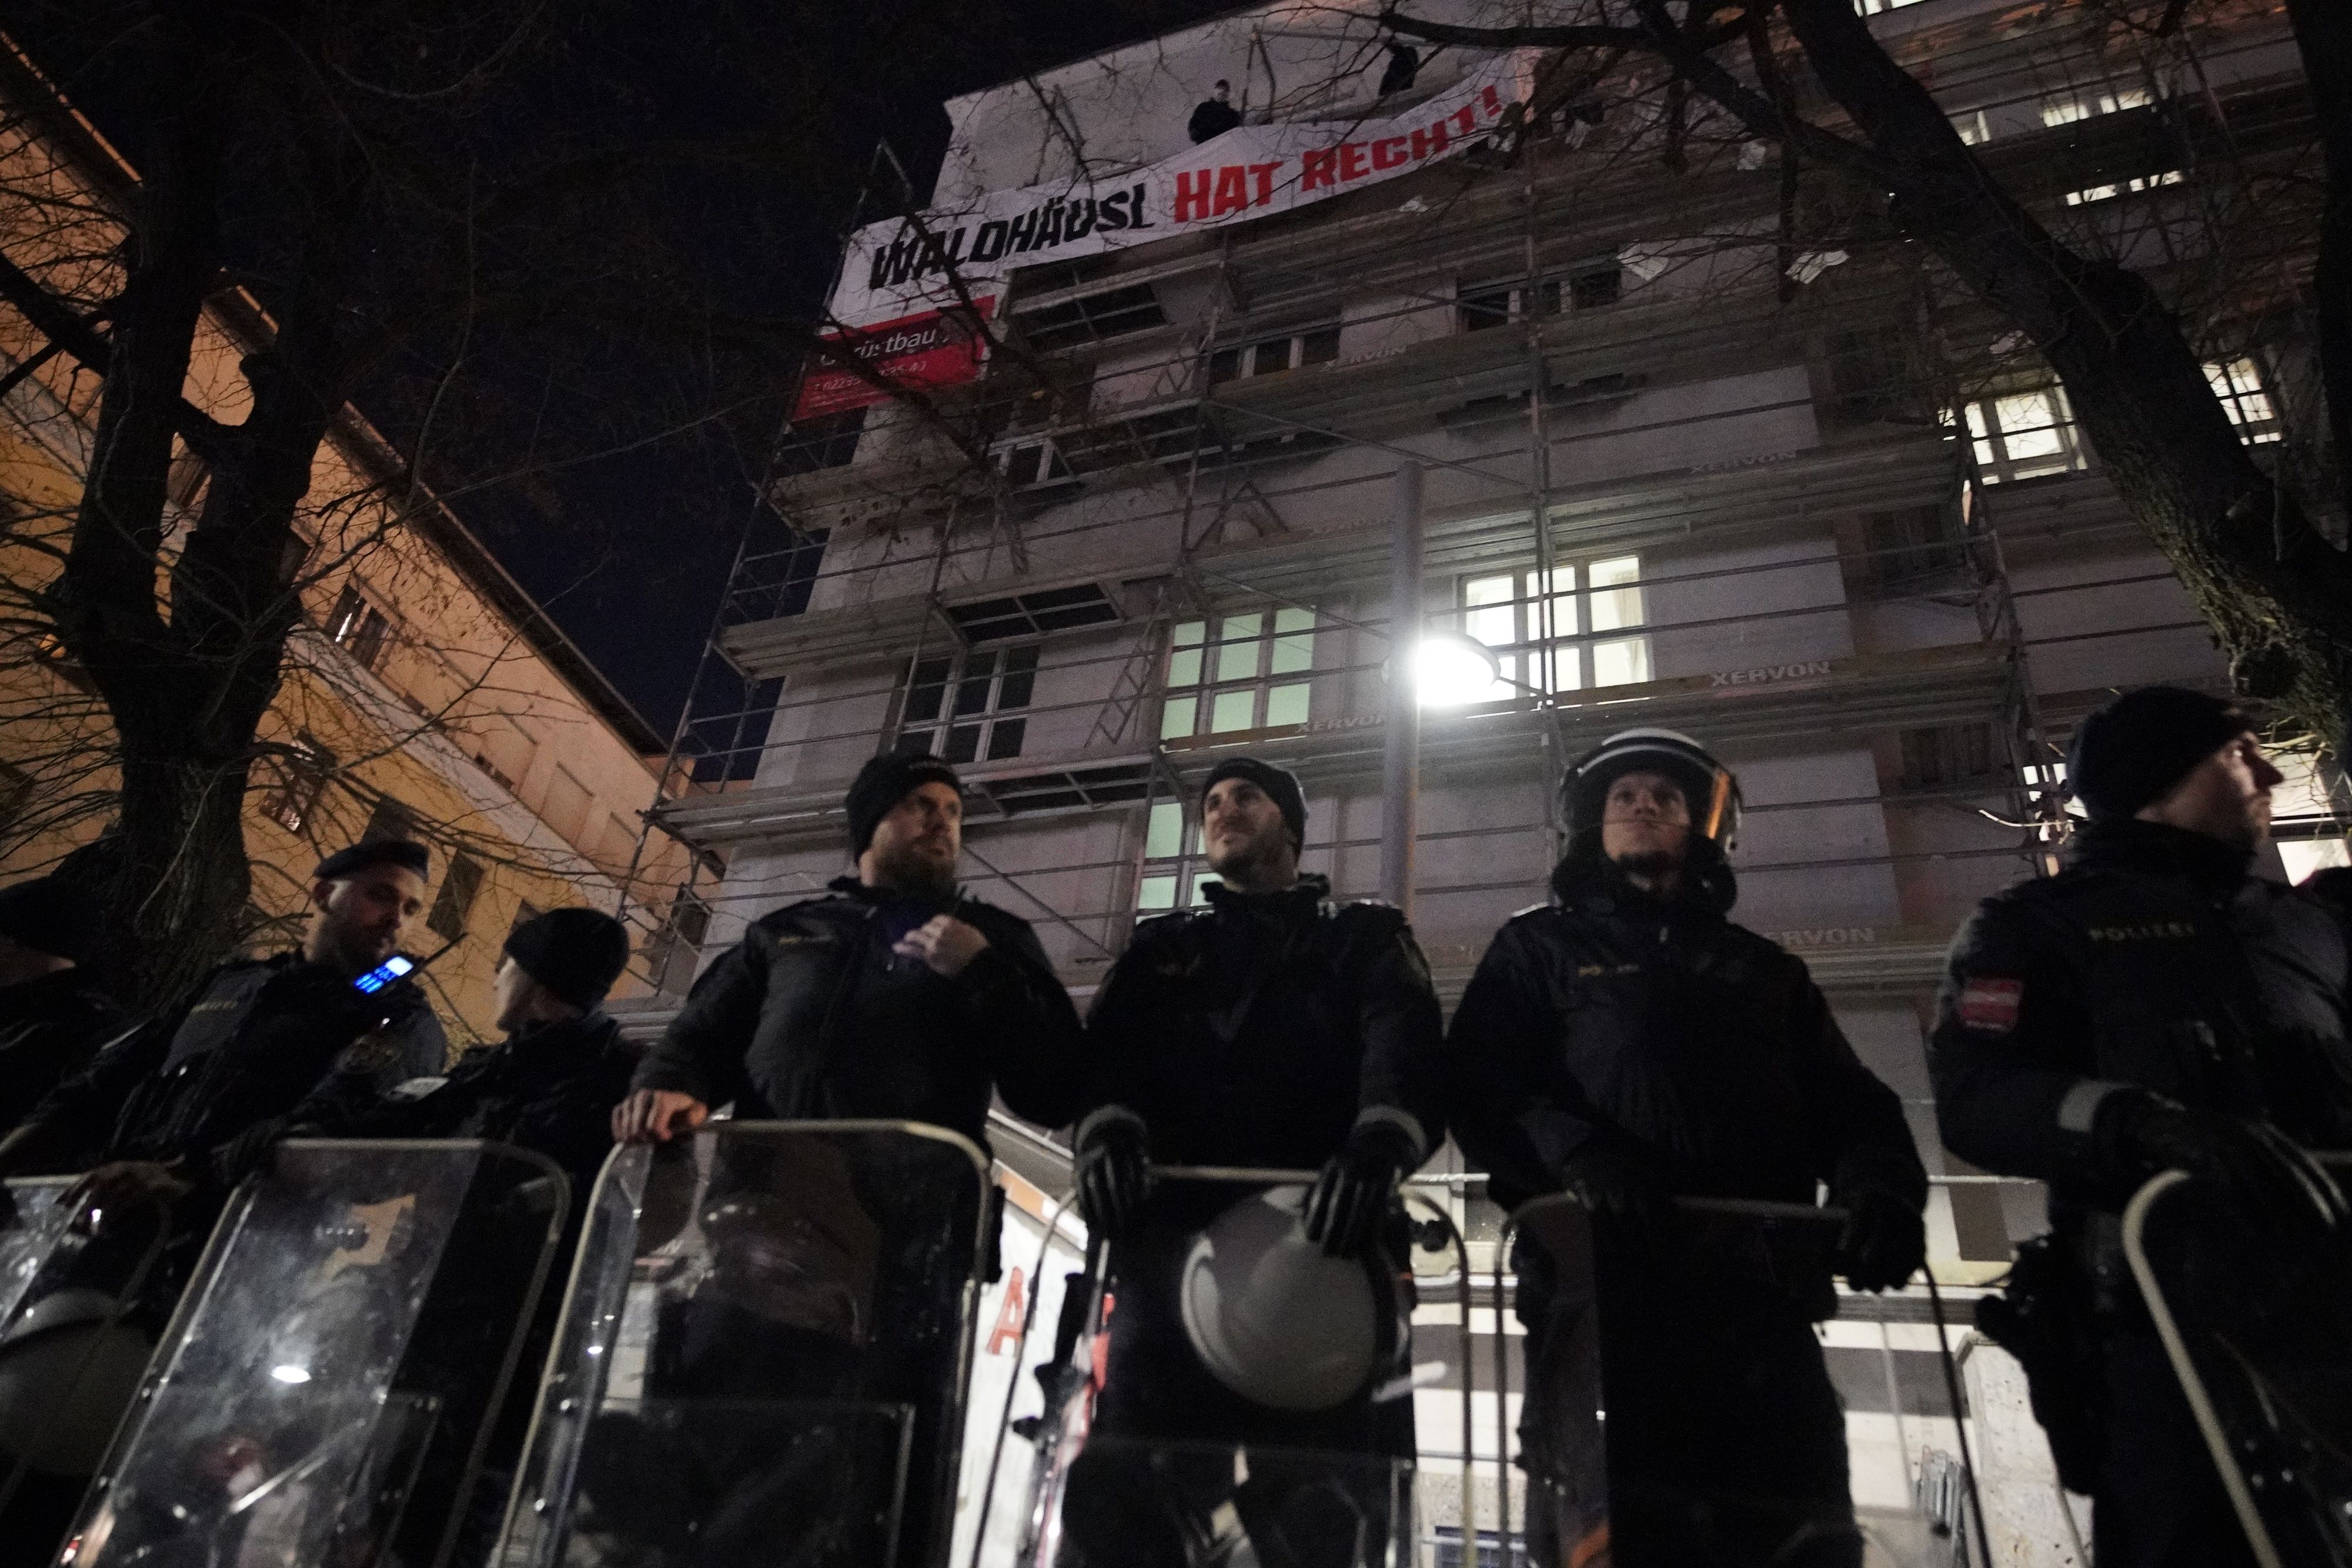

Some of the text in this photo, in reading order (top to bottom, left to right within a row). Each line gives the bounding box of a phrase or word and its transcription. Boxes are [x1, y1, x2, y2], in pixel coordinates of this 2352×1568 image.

[869, 85, 1502, 290] WALDHÄUSL HAT RECHT!
[1710, 661, 1830, 687] XERVON
[1762, 927, 1875, 947] ERVON
